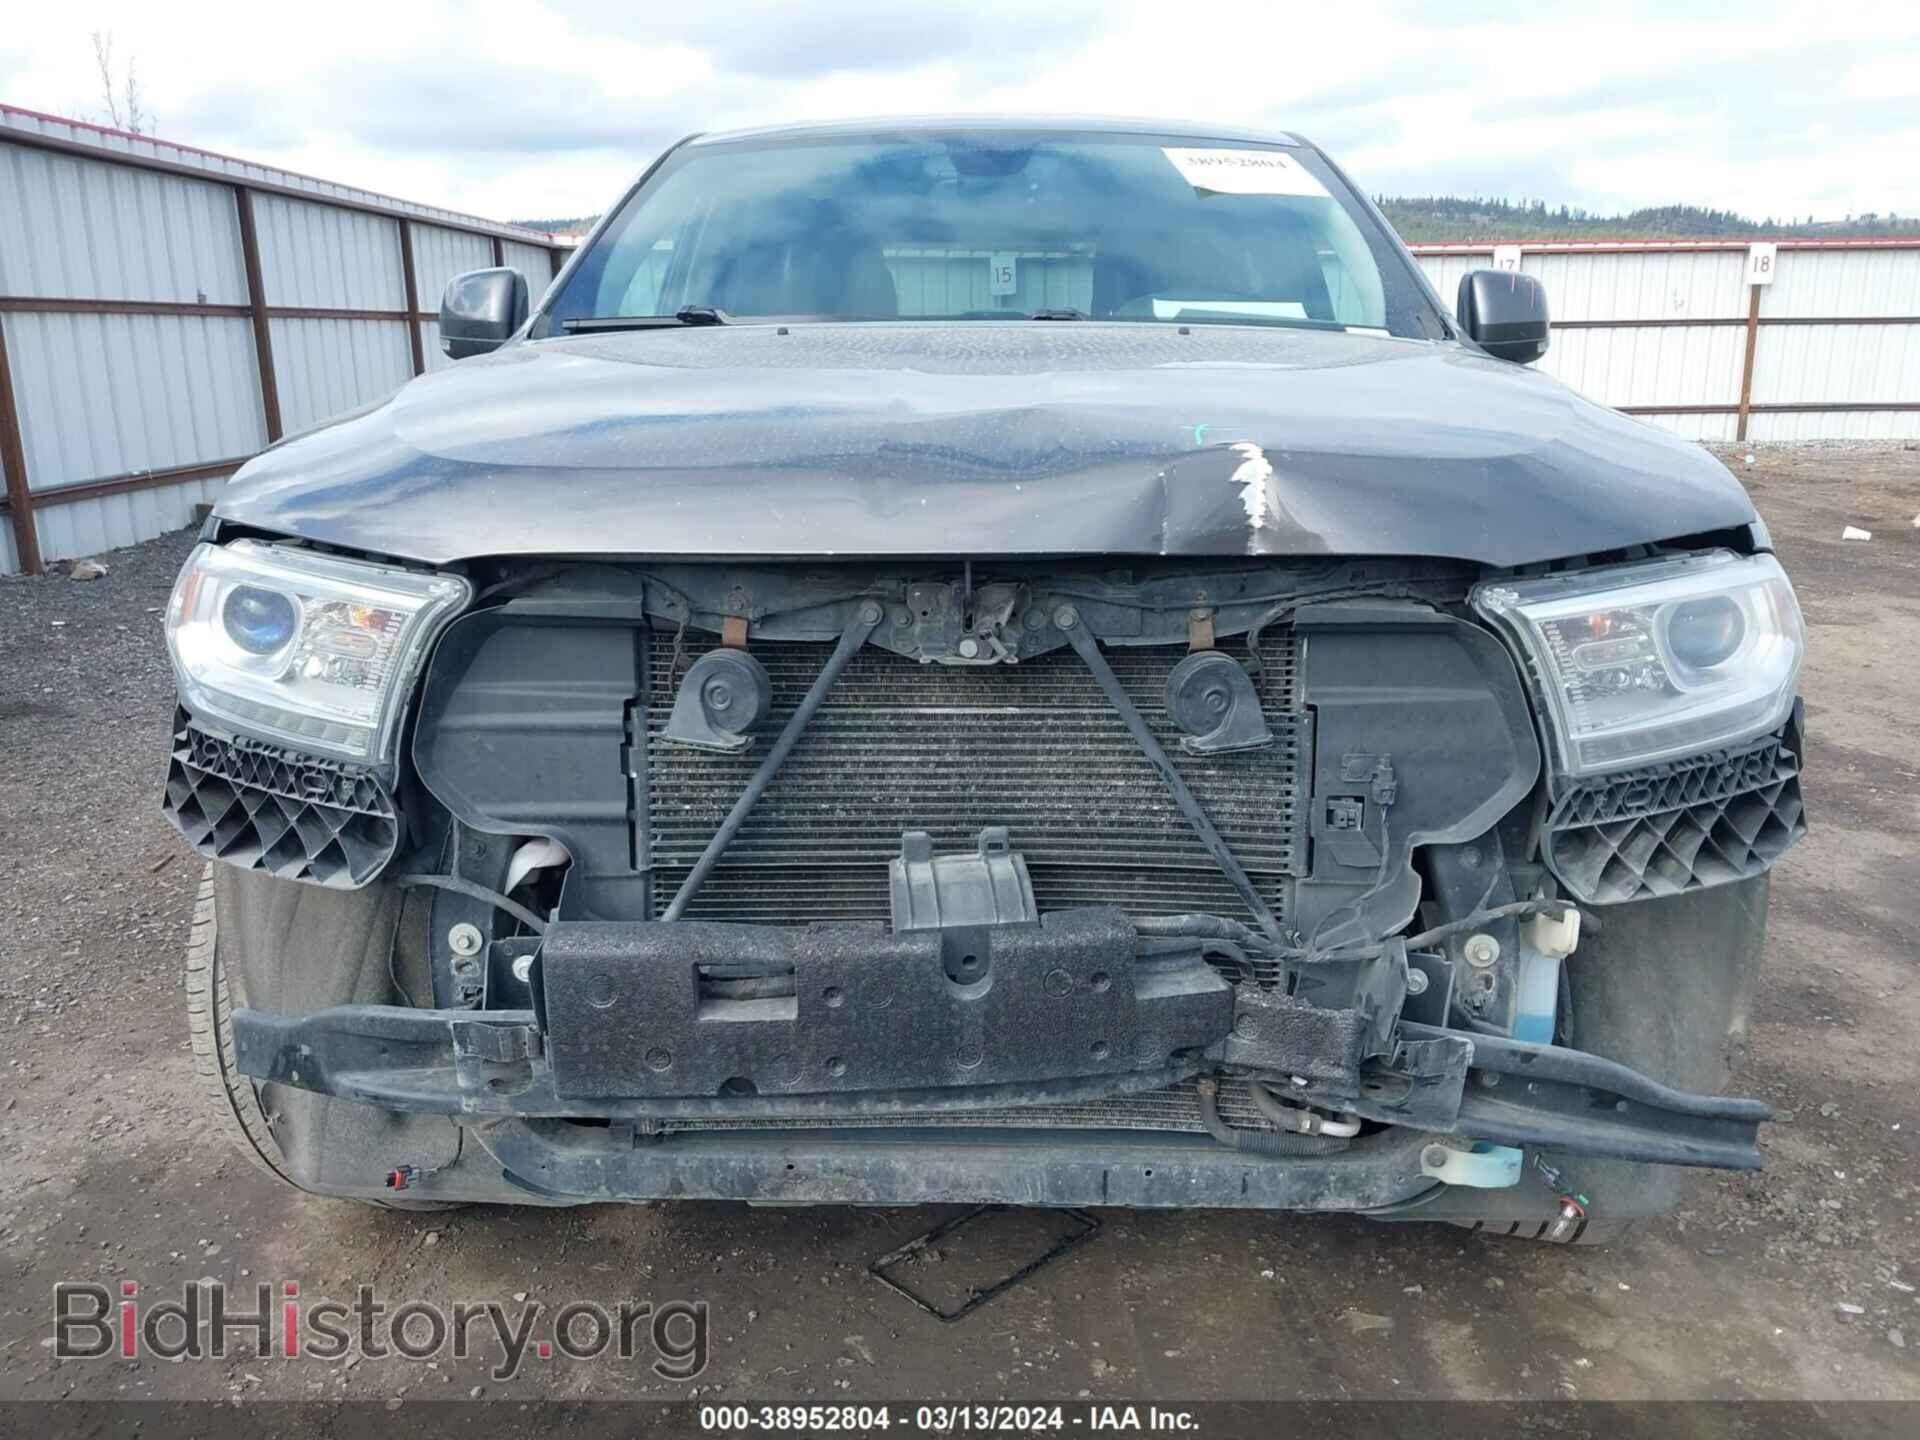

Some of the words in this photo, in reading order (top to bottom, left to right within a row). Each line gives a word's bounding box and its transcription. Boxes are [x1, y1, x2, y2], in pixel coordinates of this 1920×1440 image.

[1499, 258, 1515, 271] 17
[1753, 255, 1770, 273] 18
[994, 266, 1012, 284] 15
